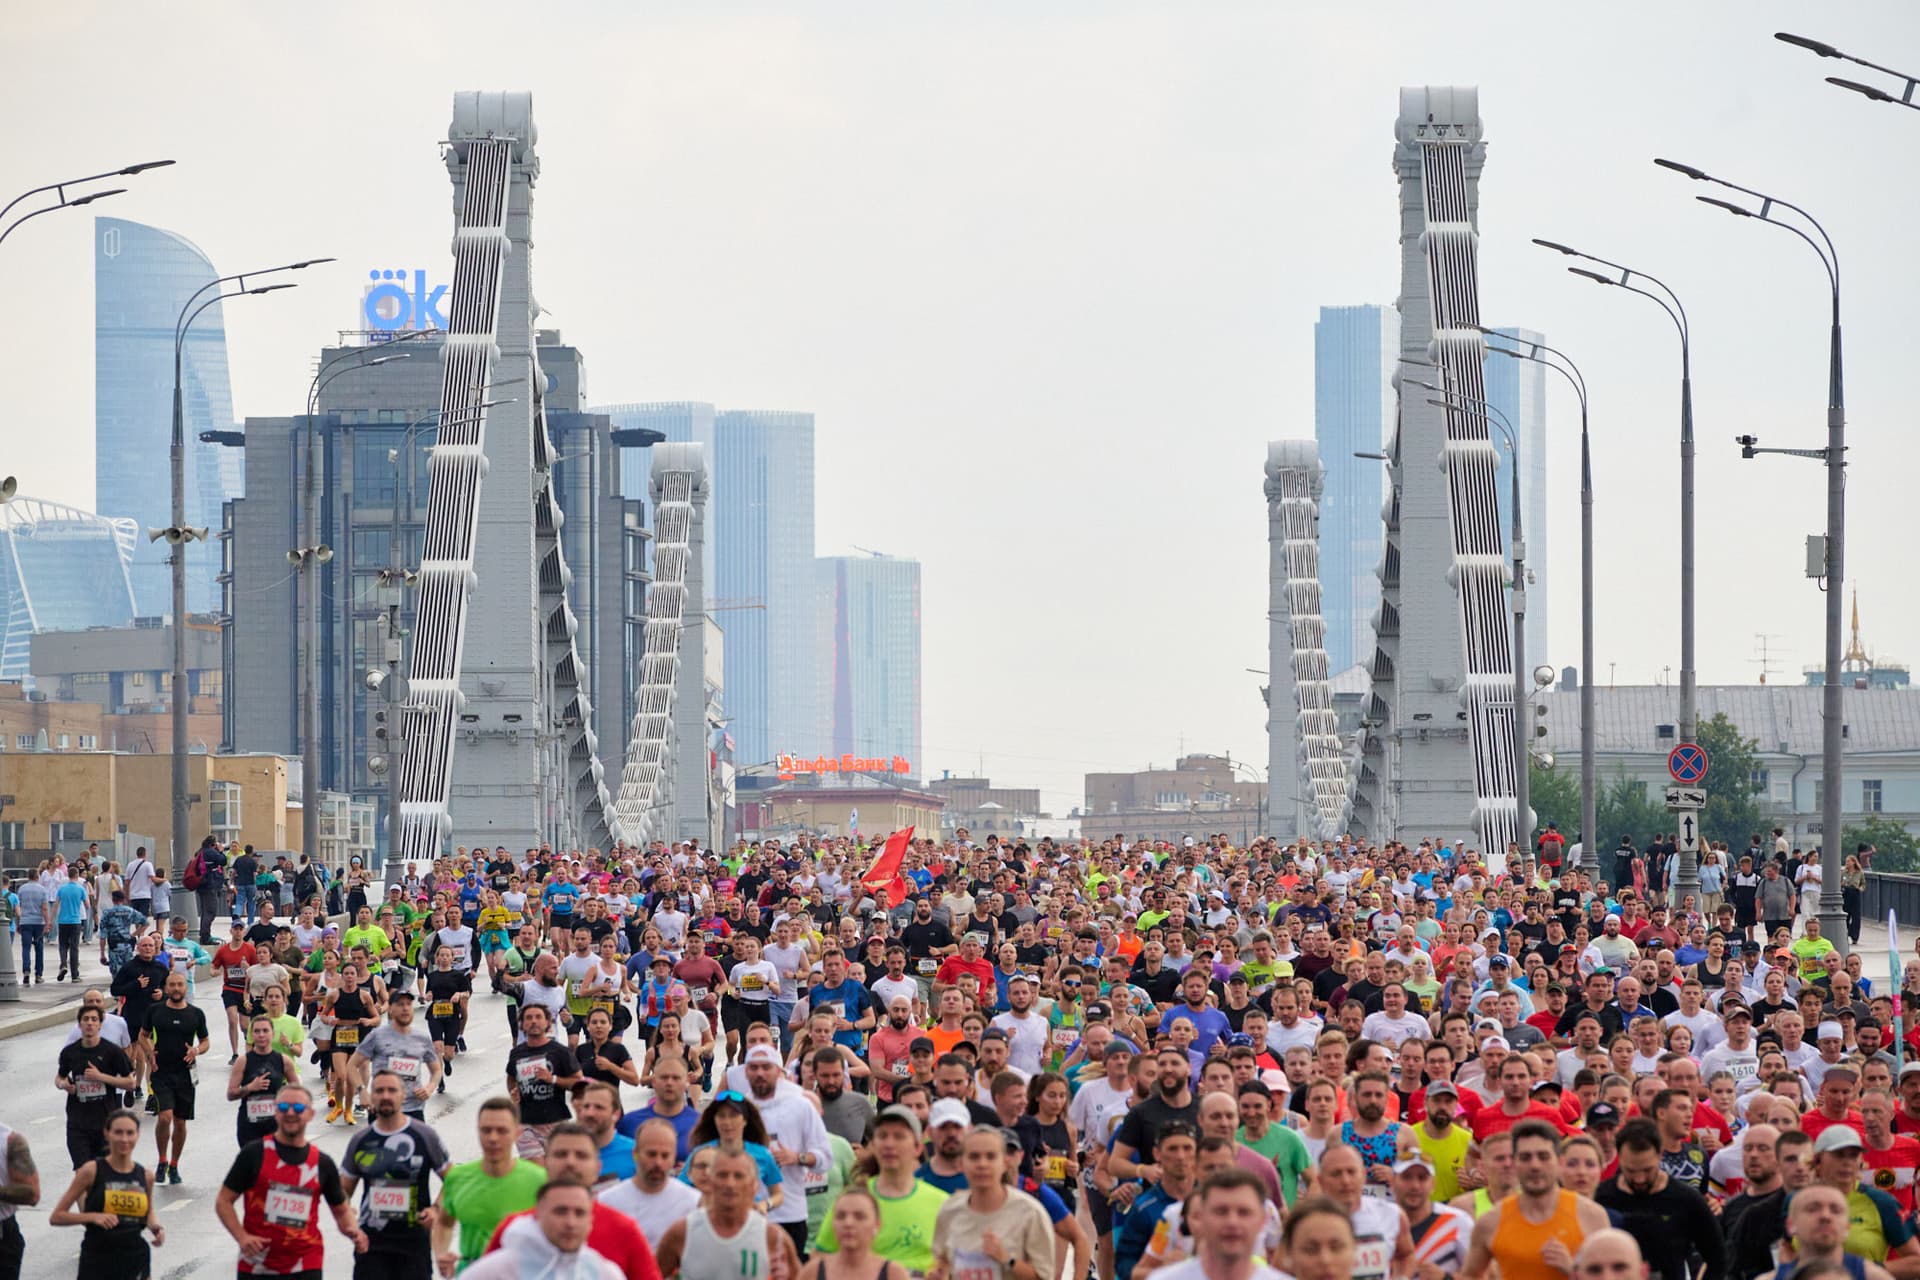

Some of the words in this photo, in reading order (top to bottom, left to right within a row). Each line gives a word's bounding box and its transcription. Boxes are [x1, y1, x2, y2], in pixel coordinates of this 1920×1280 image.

[780, 754, 839, 776] Альфа
[841, 754, 888, 772] Банк
[392, 1061, 415, 1071] 5297
[1732, 1065, 1755, 1077] 1610
[111, 1193, 142, 1210] 3351
[272, 1196, 305, 1214] 7138
